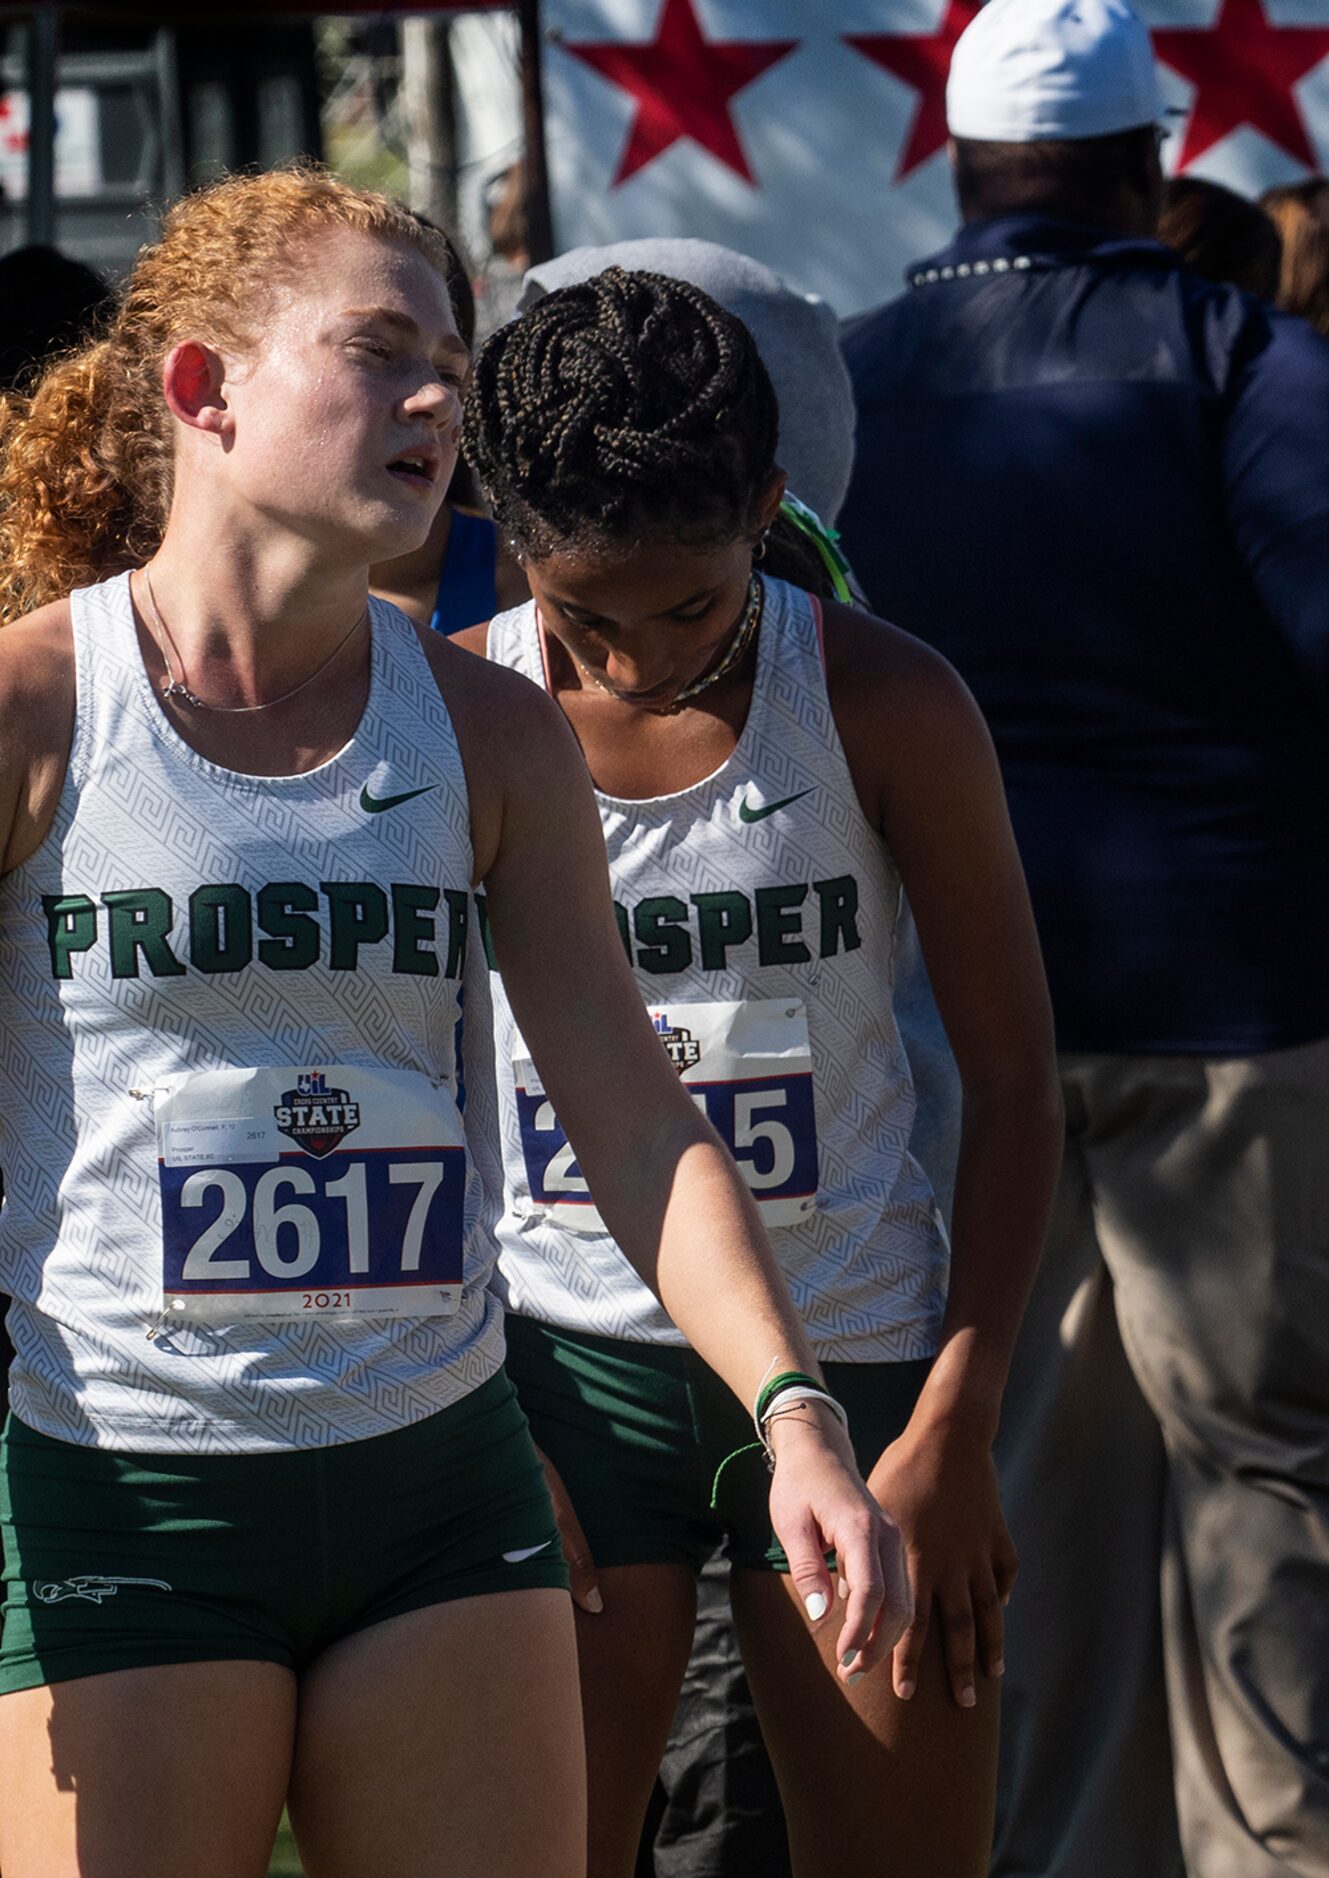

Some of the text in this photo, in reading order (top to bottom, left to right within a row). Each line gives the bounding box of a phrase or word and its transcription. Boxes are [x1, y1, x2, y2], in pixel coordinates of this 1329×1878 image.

[276, 1104, 358, 1127] STATE
[535, 1089, 796, 1192] 25
[181, 1162, 444, 1281] 2617
[302, 1293, 350, 1309] 2021
